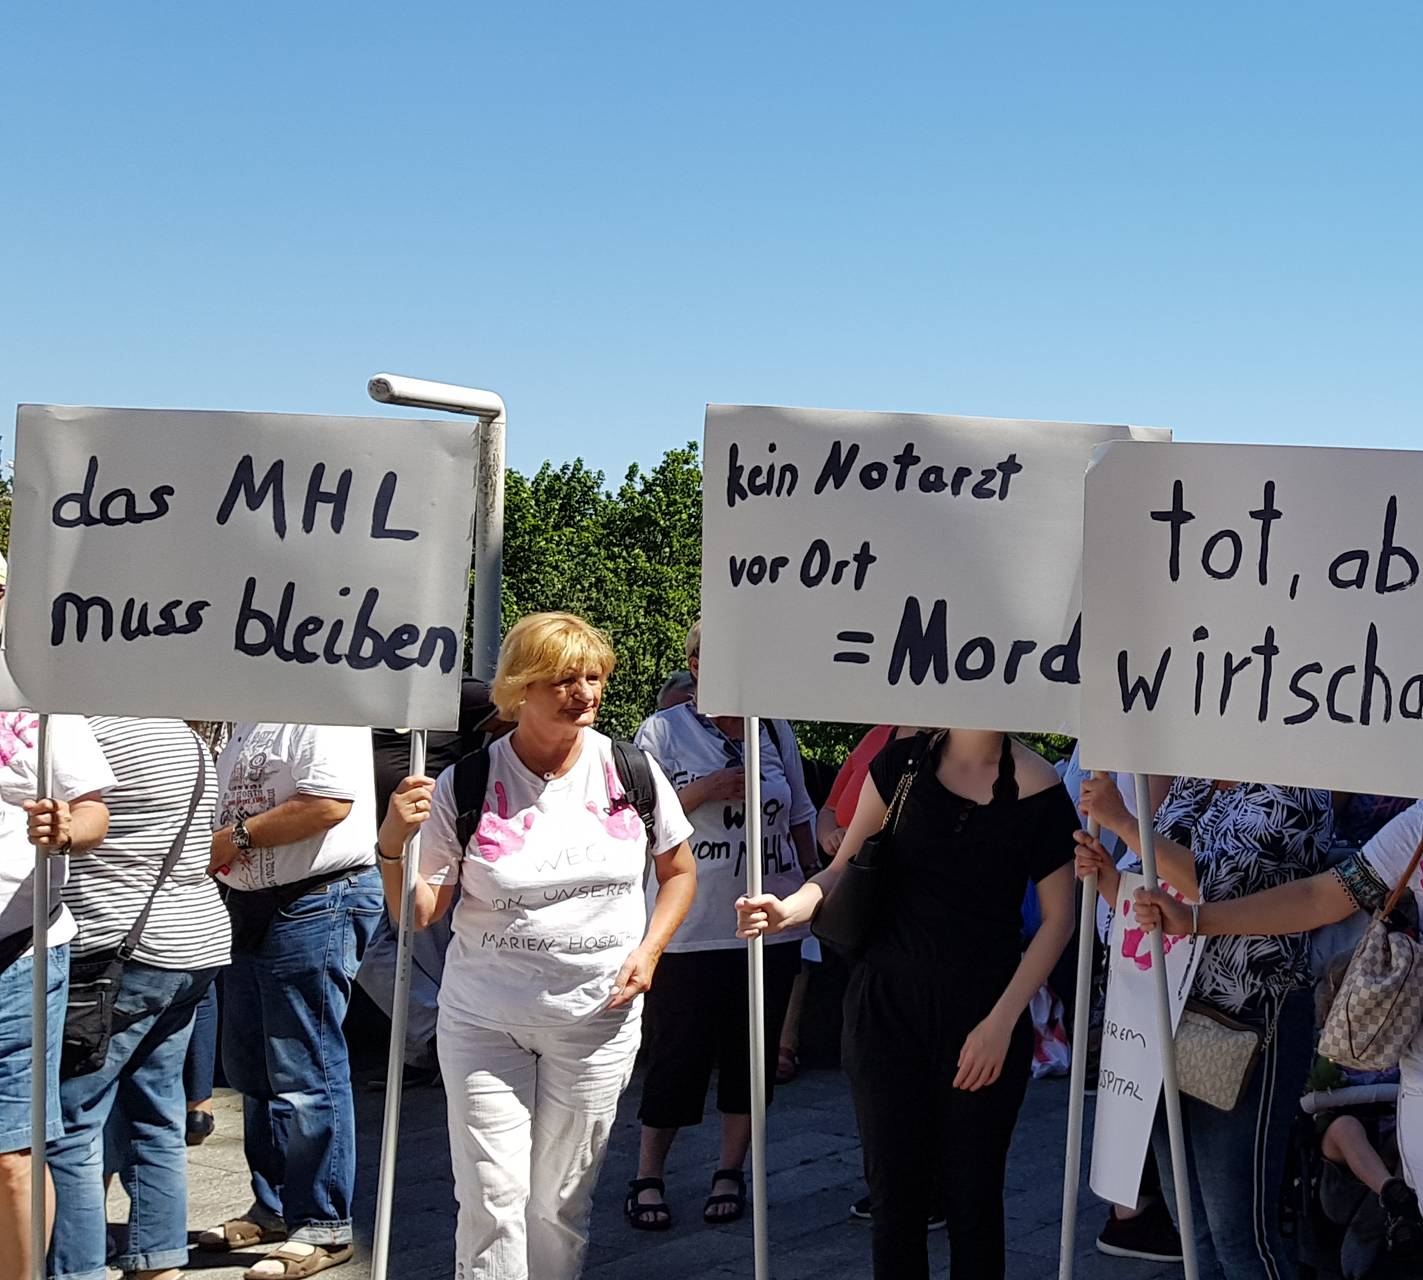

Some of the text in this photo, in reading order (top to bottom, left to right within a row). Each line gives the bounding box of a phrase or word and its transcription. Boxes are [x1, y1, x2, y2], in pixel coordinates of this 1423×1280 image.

[52, 454, 419, 541] das MHL
[726, 440, 1023, 508] kein Notarzt
[729, 537, 877, 591] vor Ort
[1150, 479, 1300, 600] tot,
[50, 576, 457, 674] muss bleiben
